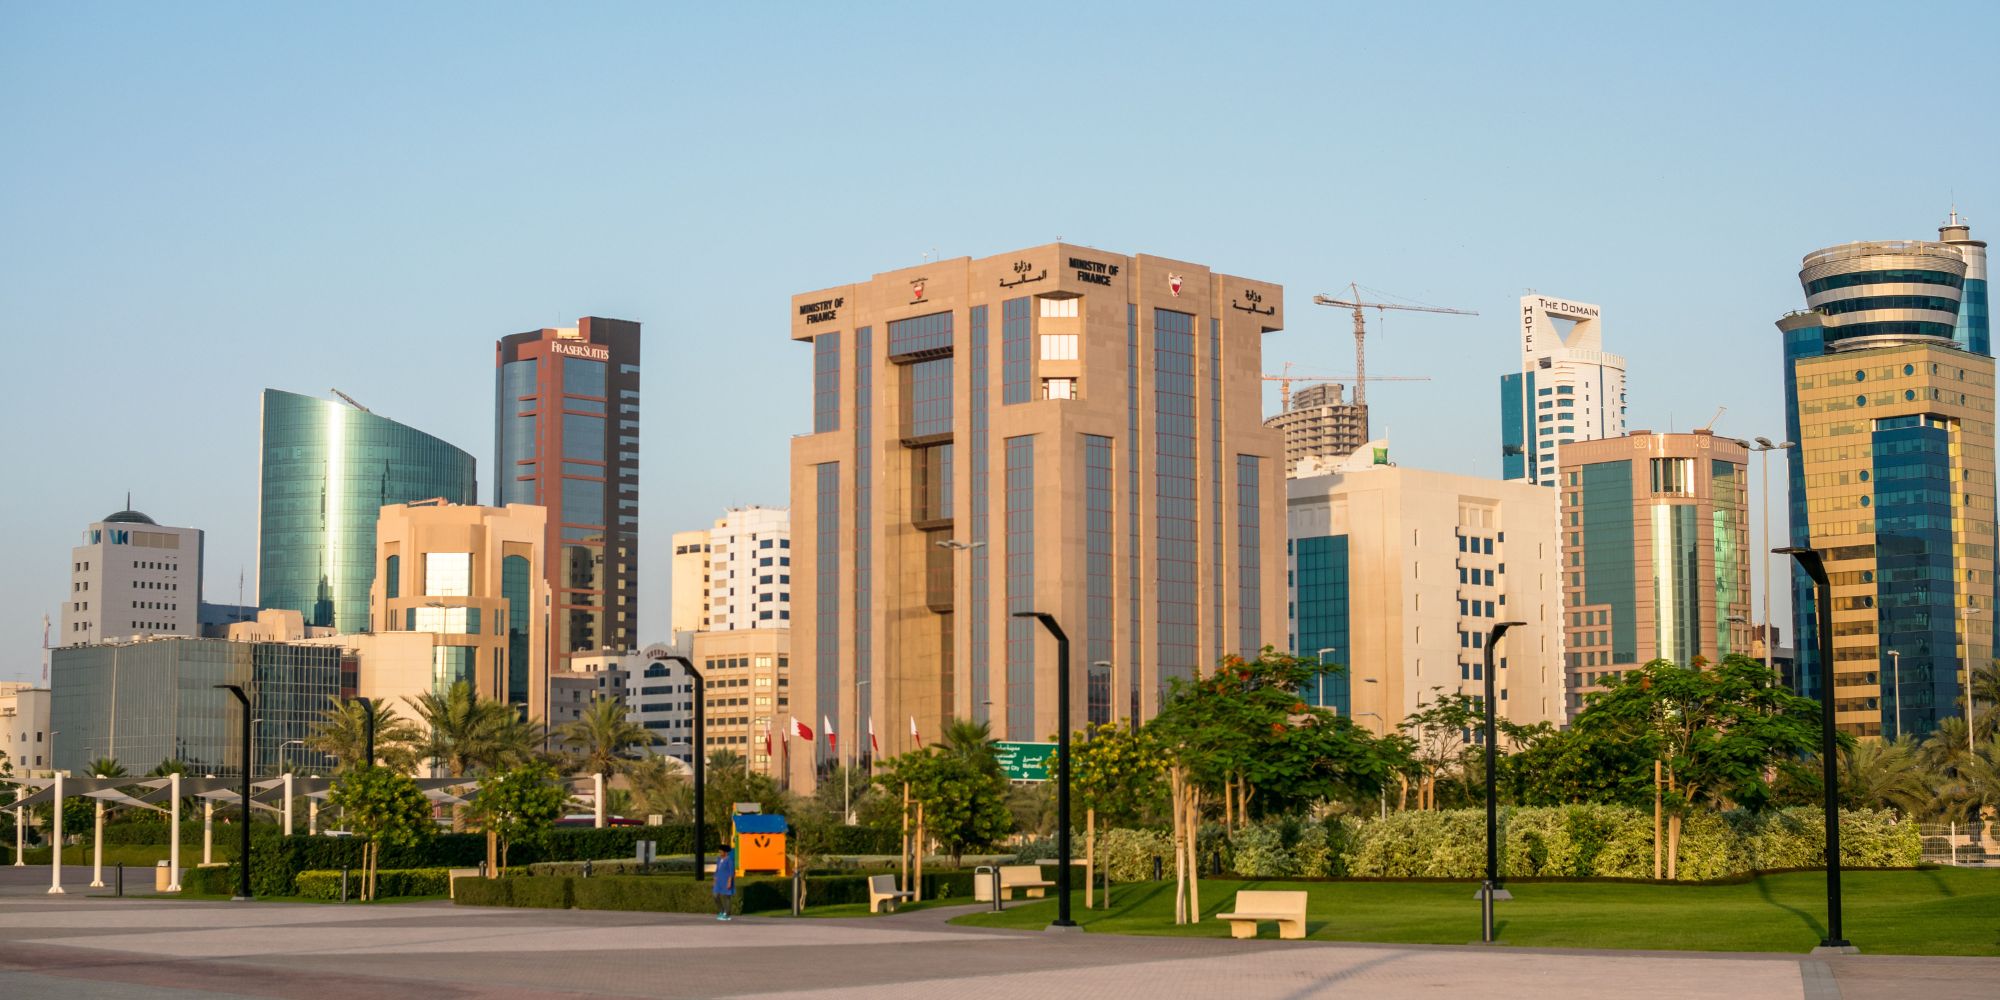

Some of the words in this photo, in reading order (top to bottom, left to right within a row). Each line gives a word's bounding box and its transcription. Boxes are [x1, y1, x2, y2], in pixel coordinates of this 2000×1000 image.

[1013, 260, 1032, 273] وزارة
[1069, 257, 1106, 273] MINISTRY
[1108, 265, 1119, 276] OF
[999, 270, 1047, 288] المالية
[1077, 270, 1111, 286] FINANCE
[1245, 289, 1262, 302] وزارة
[799, 299, 834, 315] MINISTRY
[834, 297, 844, 308] OF
[1232, 299, 1275, 316] المالية
[1538, 298, 1558, 310] THE
[1561, 302, 1599, 317] DOMAIN
[806, 310, 837, 325] FINANCE
[1523, 305, 1533, 353] HOTEL
